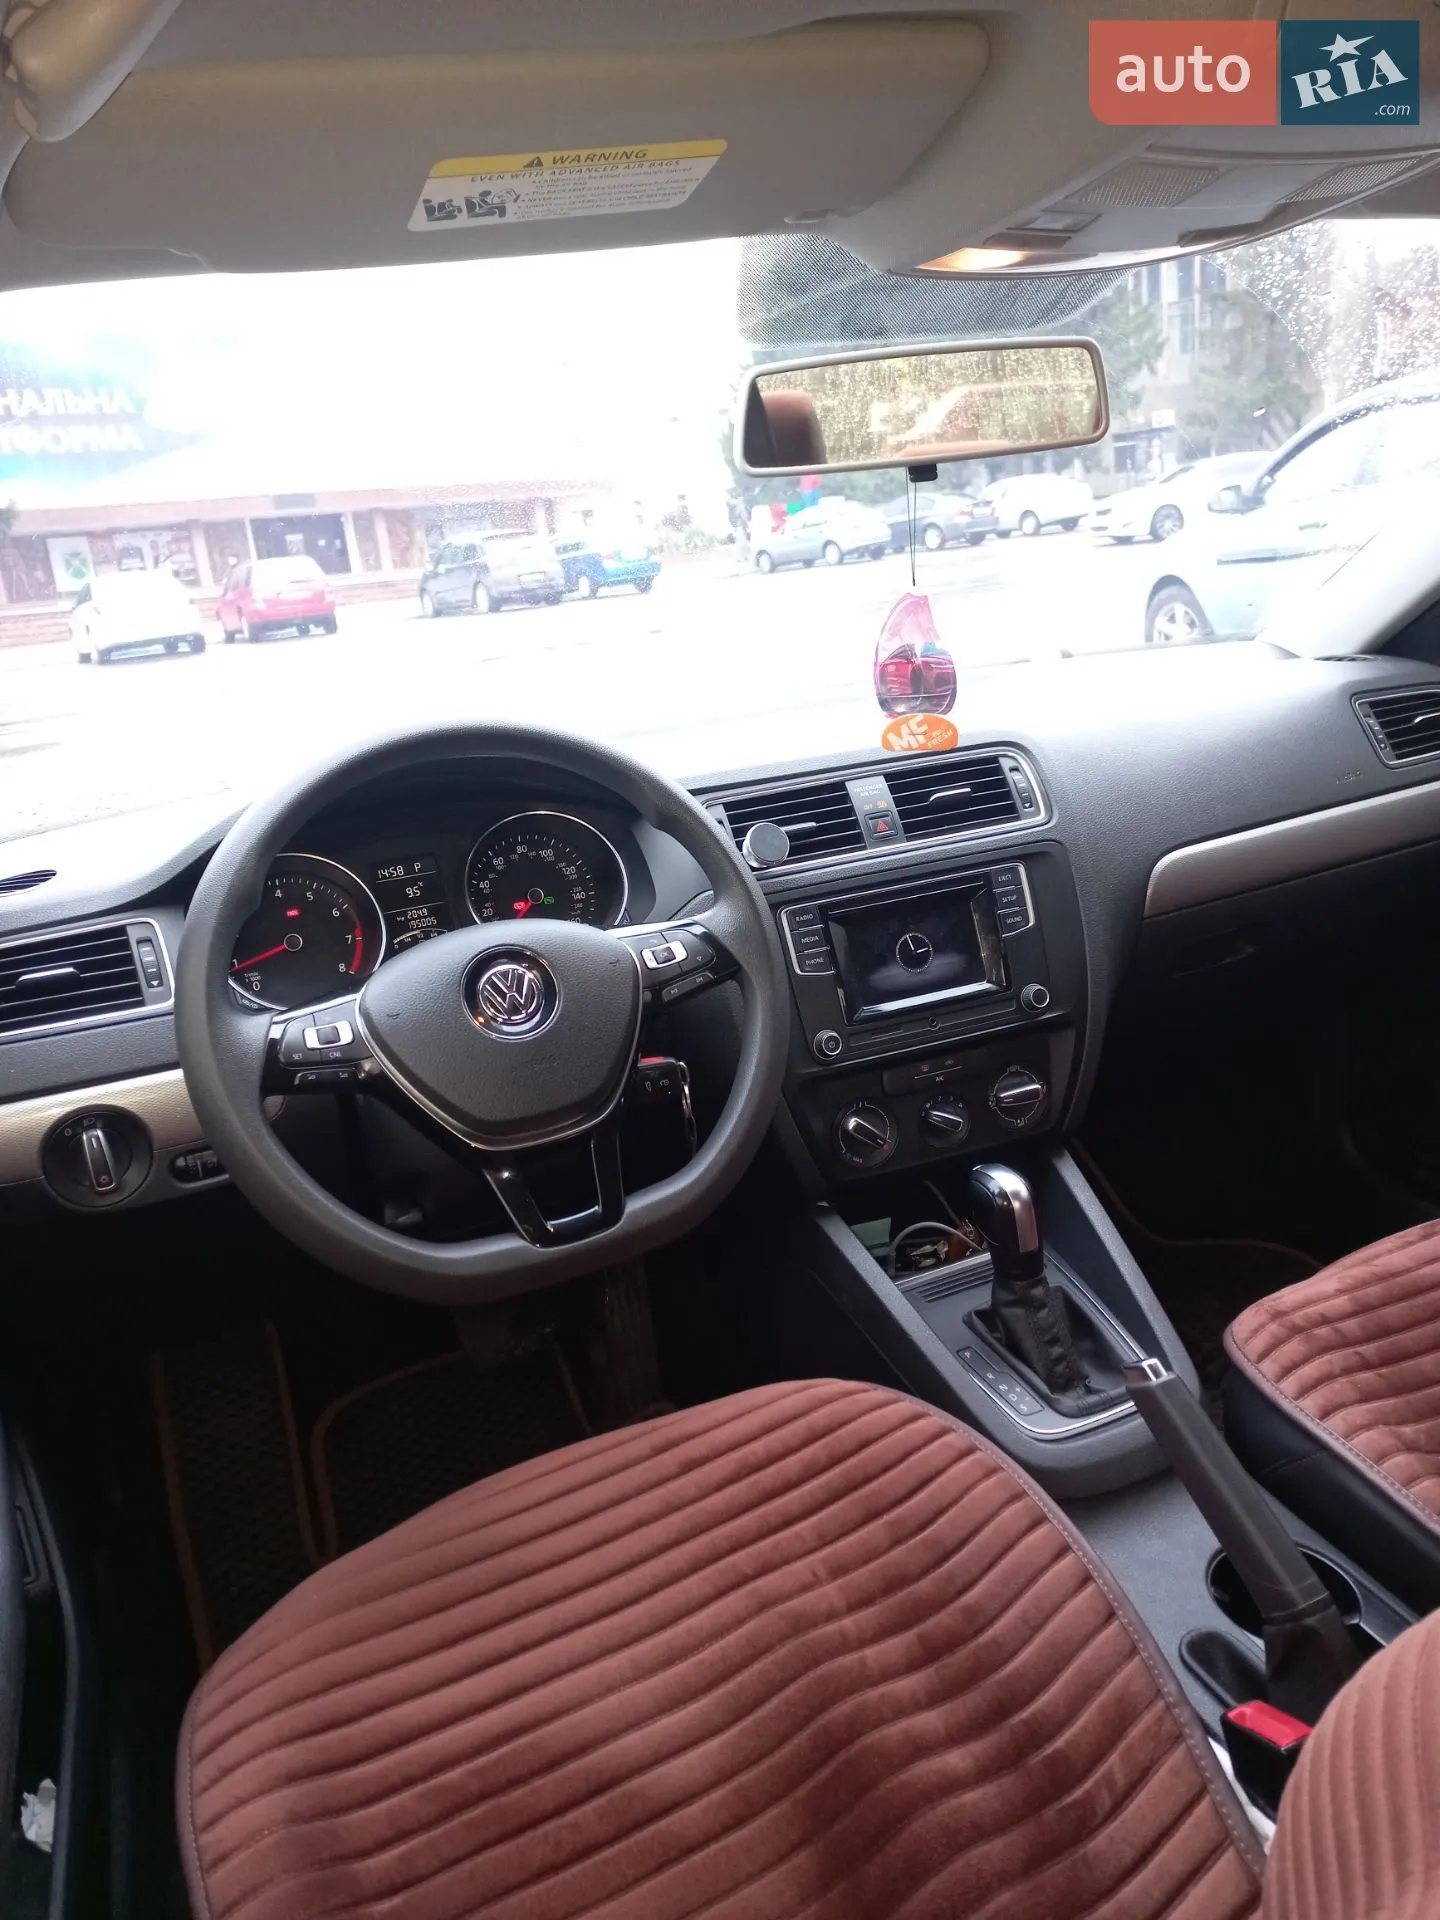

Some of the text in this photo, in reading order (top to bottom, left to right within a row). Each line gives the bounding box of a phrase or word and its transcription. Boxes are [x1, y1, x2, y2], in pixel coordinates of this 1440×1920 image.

[552, 149, 648, 166] WARNING
[471, 173, 505, 183] EVEN
[511, 170, 544, 179] WITH
[550, 165, 619, 178] ADVANCED
[623, 162, 643, 171] AIR
[648, 159, 681, 169] BAGS
[516, 844, 528, 854] 80
[539, 848, 554, 858] 100
[492, 856, 504, 866] 60
[377, 862, 421, 879] 14:58 P
[562, 866, 576, 876] 120
[479, 880, 490, 889] 40
[275, 889, 283, 898] 4
[306, 892, 314, 901] 5
[572, 892, 586, 901] 140
[332, 908, 340, 917] 6
[482, 908, 494, 918] 20
[796, 913, 814, 922] RADIO
[408, 916, 437, 929] 195005
[345, 935, 352, 944] 7
[801, 935, 820, 944] MEDIA
[805, 957, 825, 966] PHONE
[338, 963, 346, 973] 8
[252, 981, 260, 991] 0
[964, 1351, 971, 1359] P
[986, 1372, 995, 1380] R
[998, 1384, 1009, 1392] N
[1020, 1403, 1028, 1412] S
